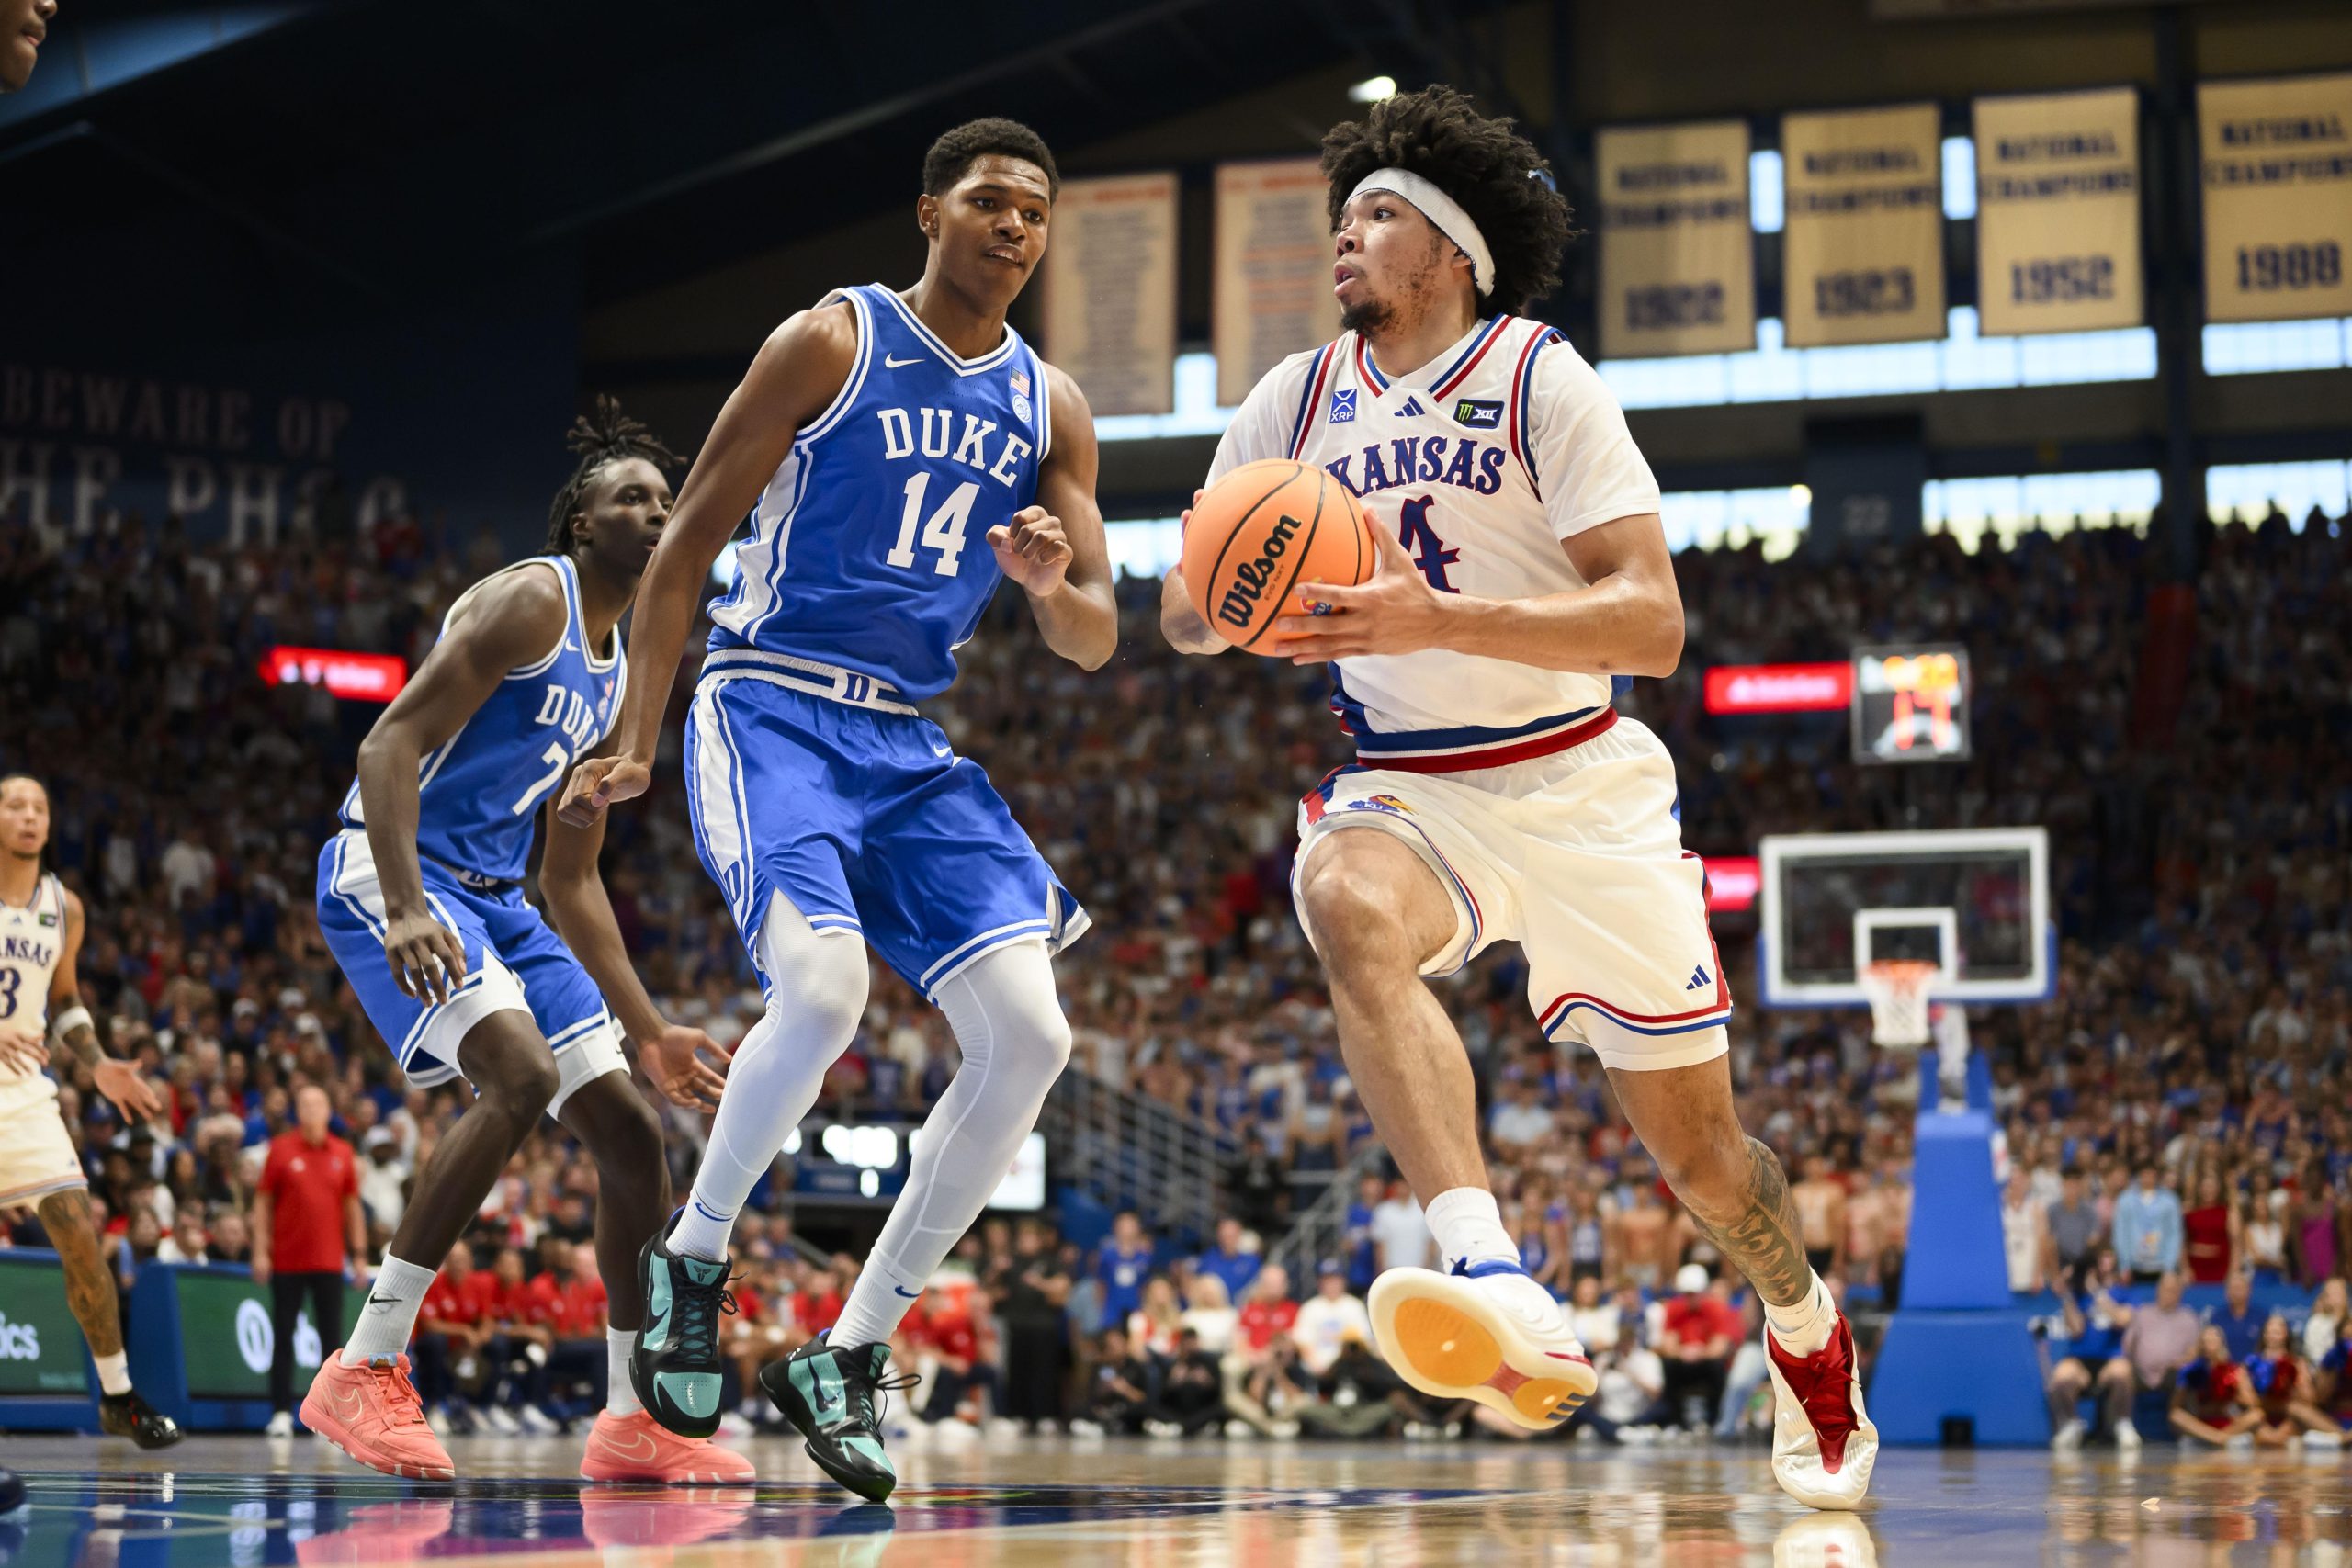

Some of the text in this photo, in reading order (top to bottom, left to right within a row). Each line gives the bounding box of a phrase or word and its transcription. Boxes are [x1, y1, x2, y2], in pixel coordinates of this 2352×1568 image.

[2220, 114, 2346, 147] NATIONAL
[2009, 255, 2114, 306] 1952
[2237, 241, 2343, 292] 1988
[1330, 411, 1354, 423] XRP
[876, 407, 1032, 488] DUKE
[1325, 436, 1507, 498] KANSAS
[886, 471, 980, 577] 14
[1398, 494, 1461, 594] 4
[1218, 514, 1302, 628] Wilson
[842, 672, 871, 703] D
[512, 740, 569, 816] 7
[0, 937, 52, 967] NSAS
